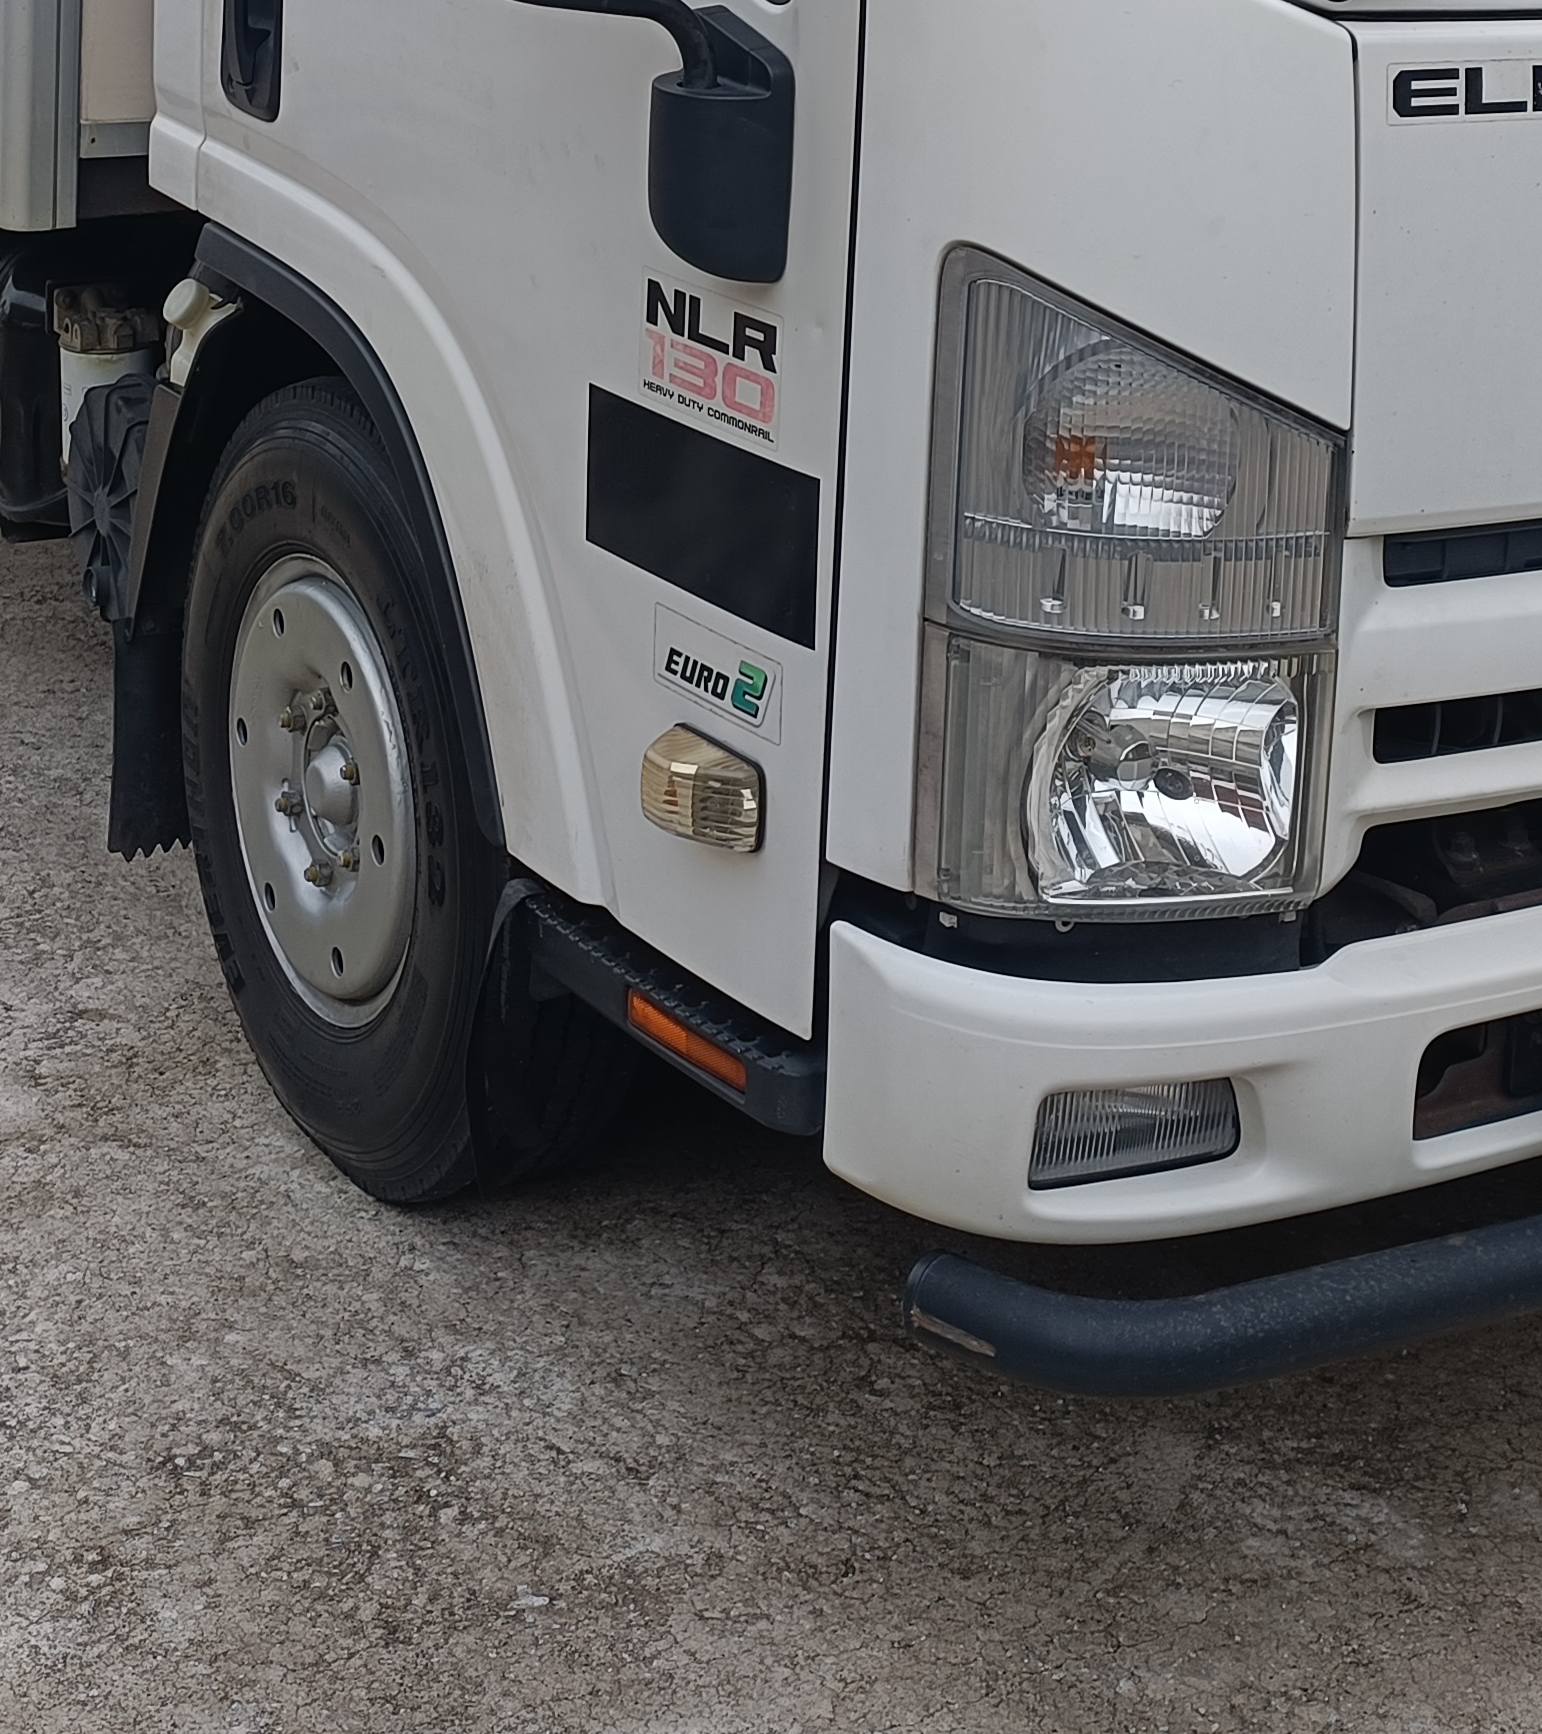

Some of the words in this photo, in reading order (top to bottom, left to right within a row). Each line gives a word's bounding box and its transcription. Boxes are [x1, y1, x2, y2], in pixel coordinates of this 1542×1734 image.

[646, 278, 778, 374] NLR
[643, 378, 675, 400] HEAVY
[677, 393, 704, 412] DUTY
[707, 406, 775, 444] COMMONRAIL
[645, 327, 776, 424] 130
[665, 646, 730, 701] EURO
[731, 660, 768, 719] 2
